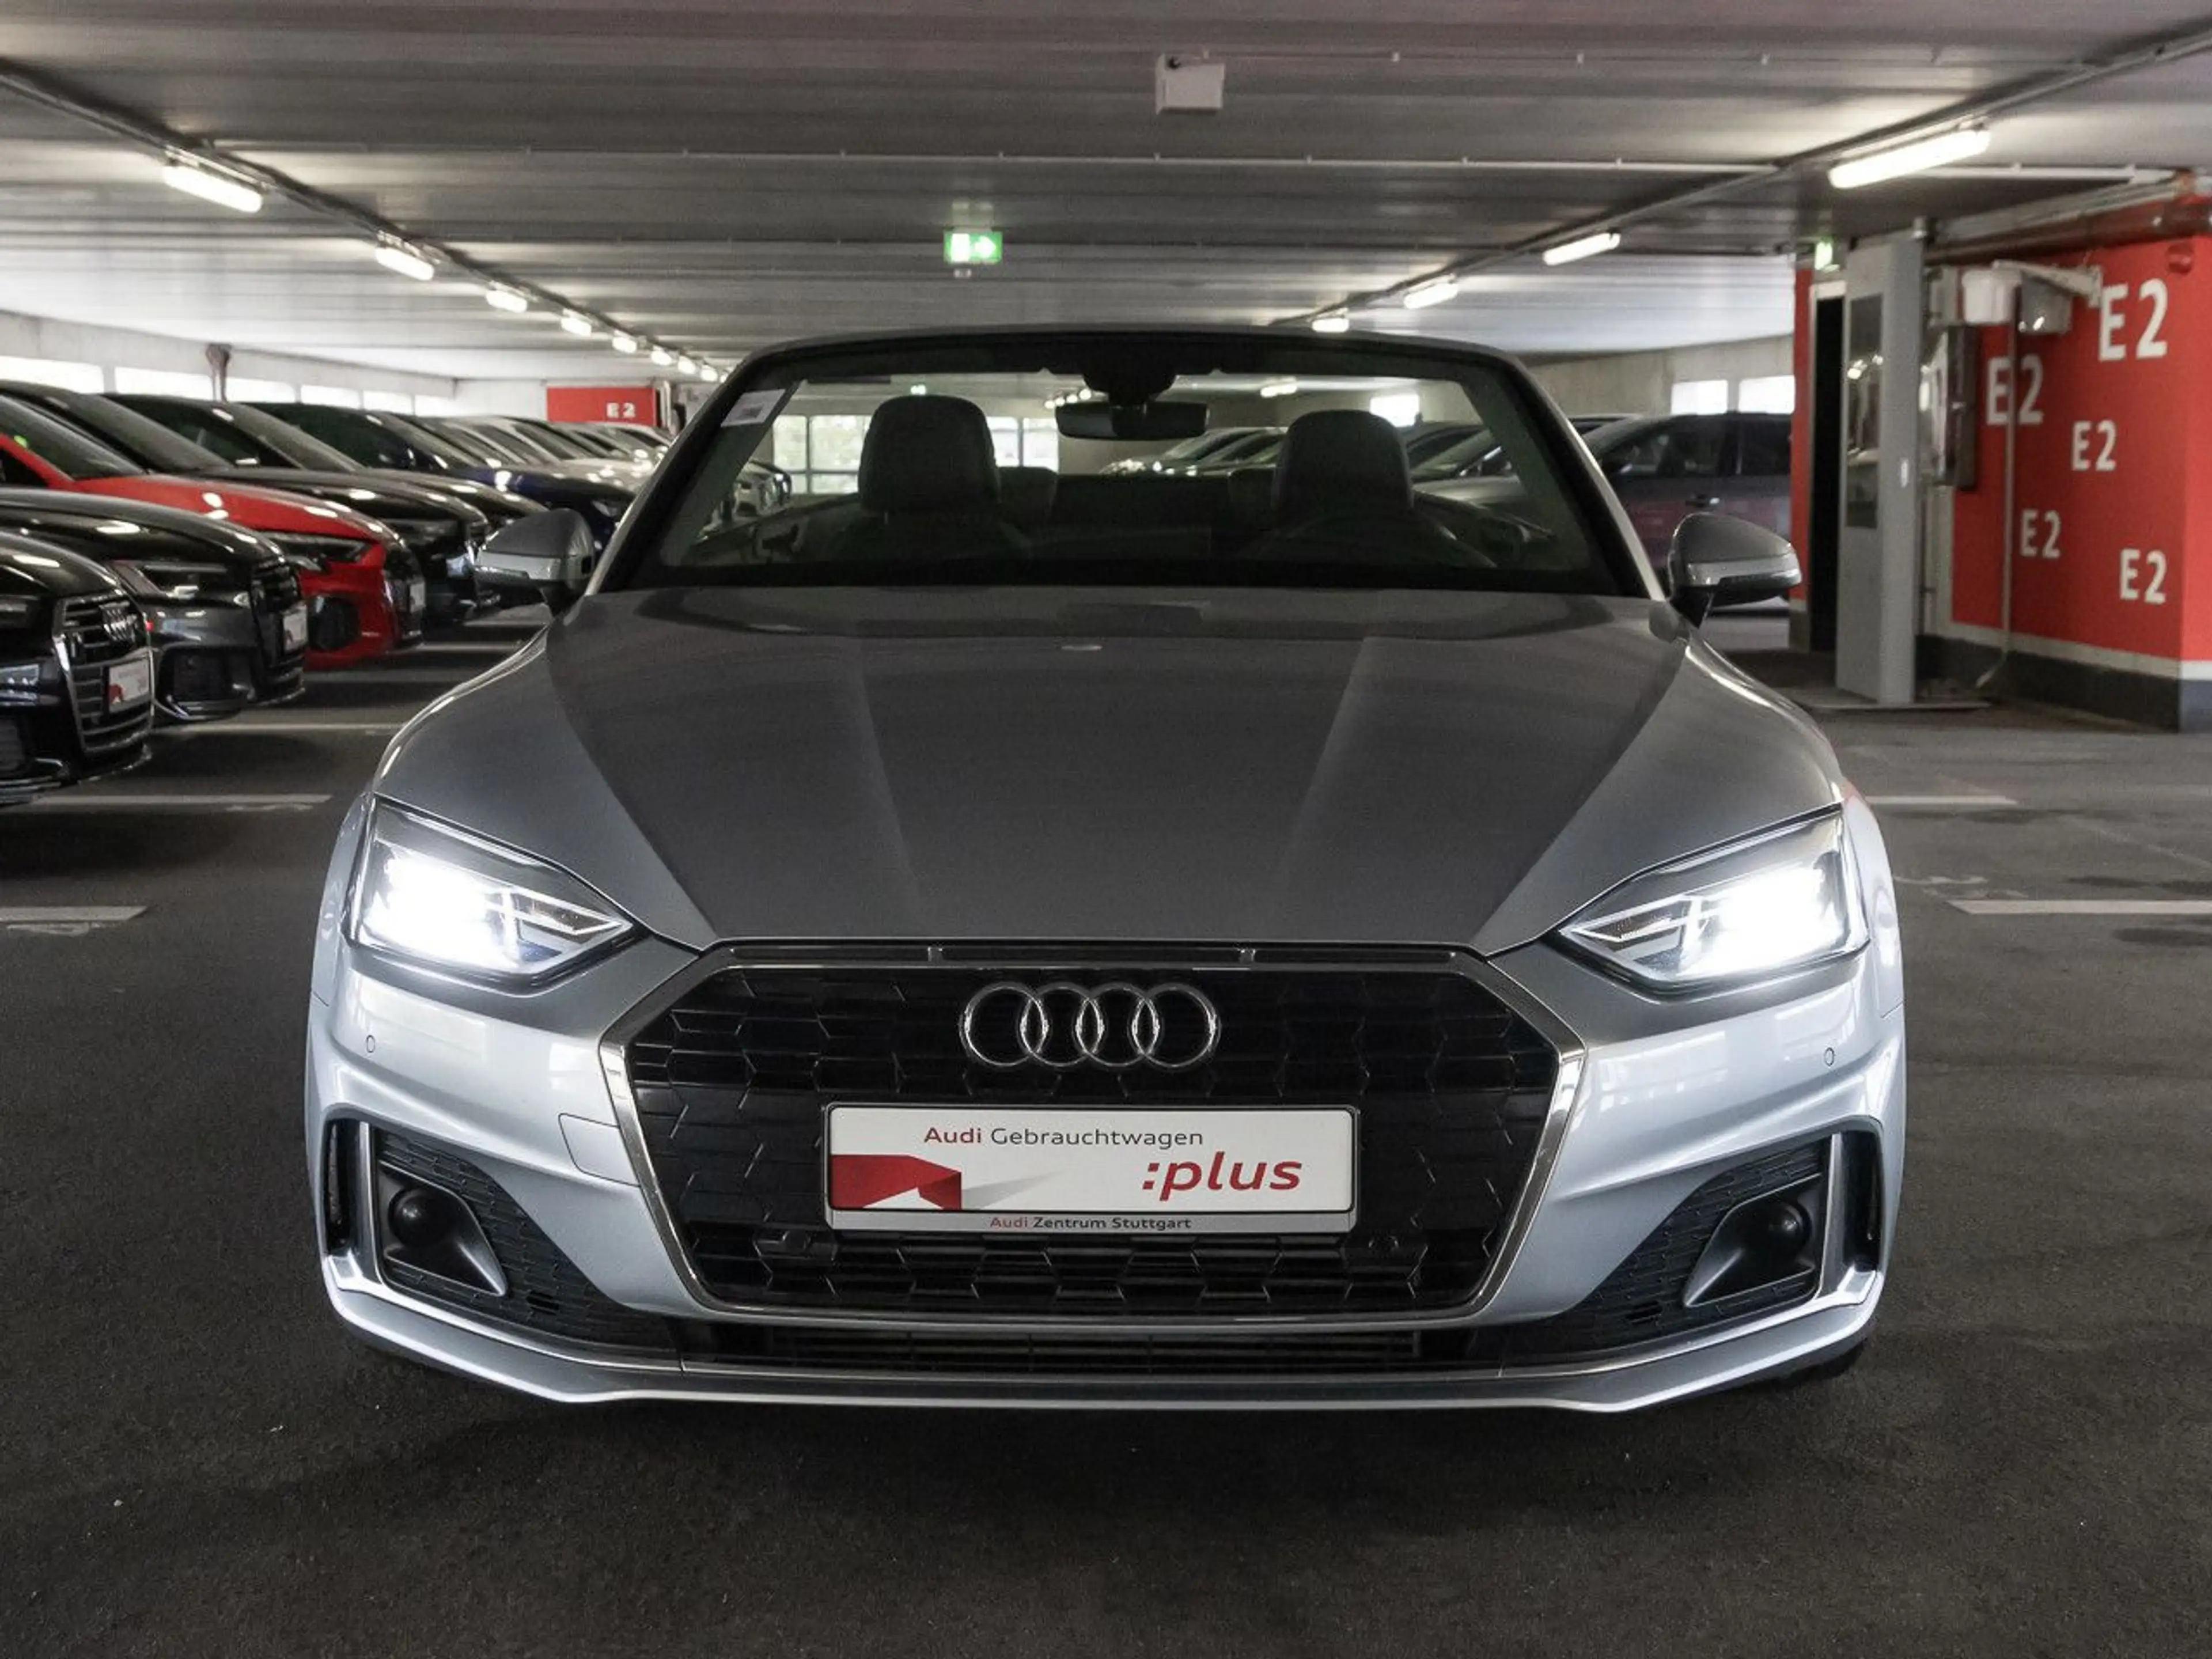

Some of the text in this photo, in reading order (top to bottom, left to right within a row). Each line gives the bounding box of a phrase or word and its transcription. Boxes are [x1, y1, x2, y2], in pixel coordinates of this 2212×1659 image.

[2098, 278, 2168, 361] E2
[1986, 354, 2044, 426] E2
[2071, 420, 2116, 472] E2
[2020, 510, 2061, 559] E2
[2119, 549, 2166, 604] E2
[924, 1127, 1204, 1149] Audi Gebrauchtwagen
[1142, 1152, 1302, 1201] :plus
[990, 1217, 1192, 1231] Audi Zentrum Stuttgart
